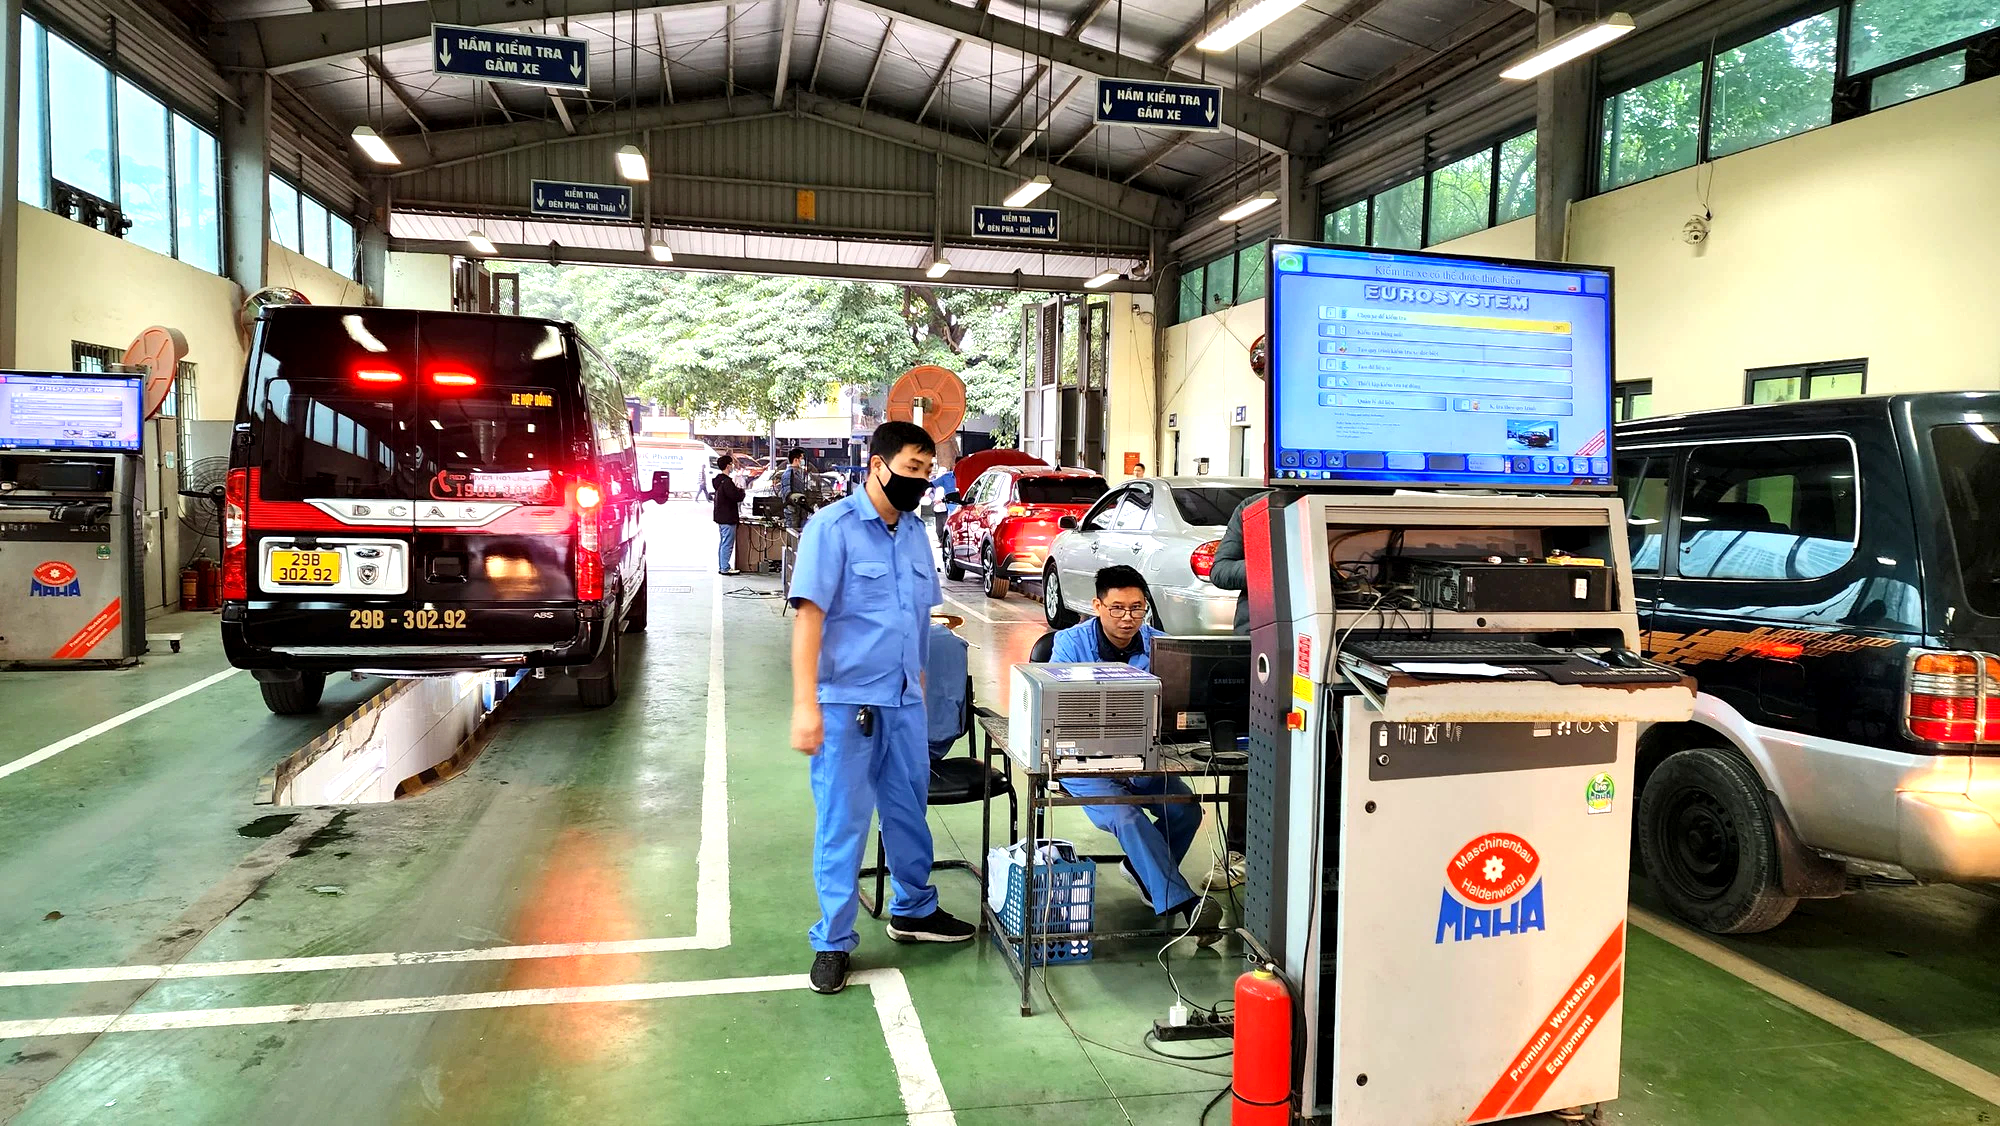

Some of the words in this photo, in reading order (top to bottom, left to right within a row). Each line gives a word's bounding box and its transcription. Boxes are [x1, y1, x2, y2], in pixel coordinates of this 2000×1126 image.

[495, 39, 532, 56] KIỂM
[536, 46, 563, 60] TRA
[522, 63, 540, 75] XE
[1147, 88, 1176, 104] KIỂM
[1179, 94, 1200, 106] TRA
[1167, 110, 1181, 120] XE
[585, 191, 599, 200] TRA
[565, 201, 580, 210] PHA
[1018, 215, 1031, 224] TRA
[1001, 225, 1015, 233] PHA
[1375, 264, 1400, 277] Kiểm
[1403, 268, 1414, 278] tra
[1417, 270, 1428, 278] xe
[1364, 284, 1530, 311] EUROSYSTEM
[652, 453, 684, 461] Pharma
[456, 483, 497, 497] 1900
[351, 504, 478, 519] DCAR
[291, 553, 320, 566] 29B
[279, 567, 332, 581] 302.92
[30, 577, 81, 597] MAHA
[349, 609, 385, 629] 29B
[403, 609, 466, 629] 302.92
[533, 611, 554, 619] ABS
[1455, 836, 1533, 870] Maschinenbau
[1461, 873, 1526, 901] Haldenwang
[1435, 876, 1545, 944] MAHA
[1510, 1031, 1551, 1081] Premium
[1550, 974, 1596, 1029] Workshop
[1545, 1014, 1594, 1075] Equipment
